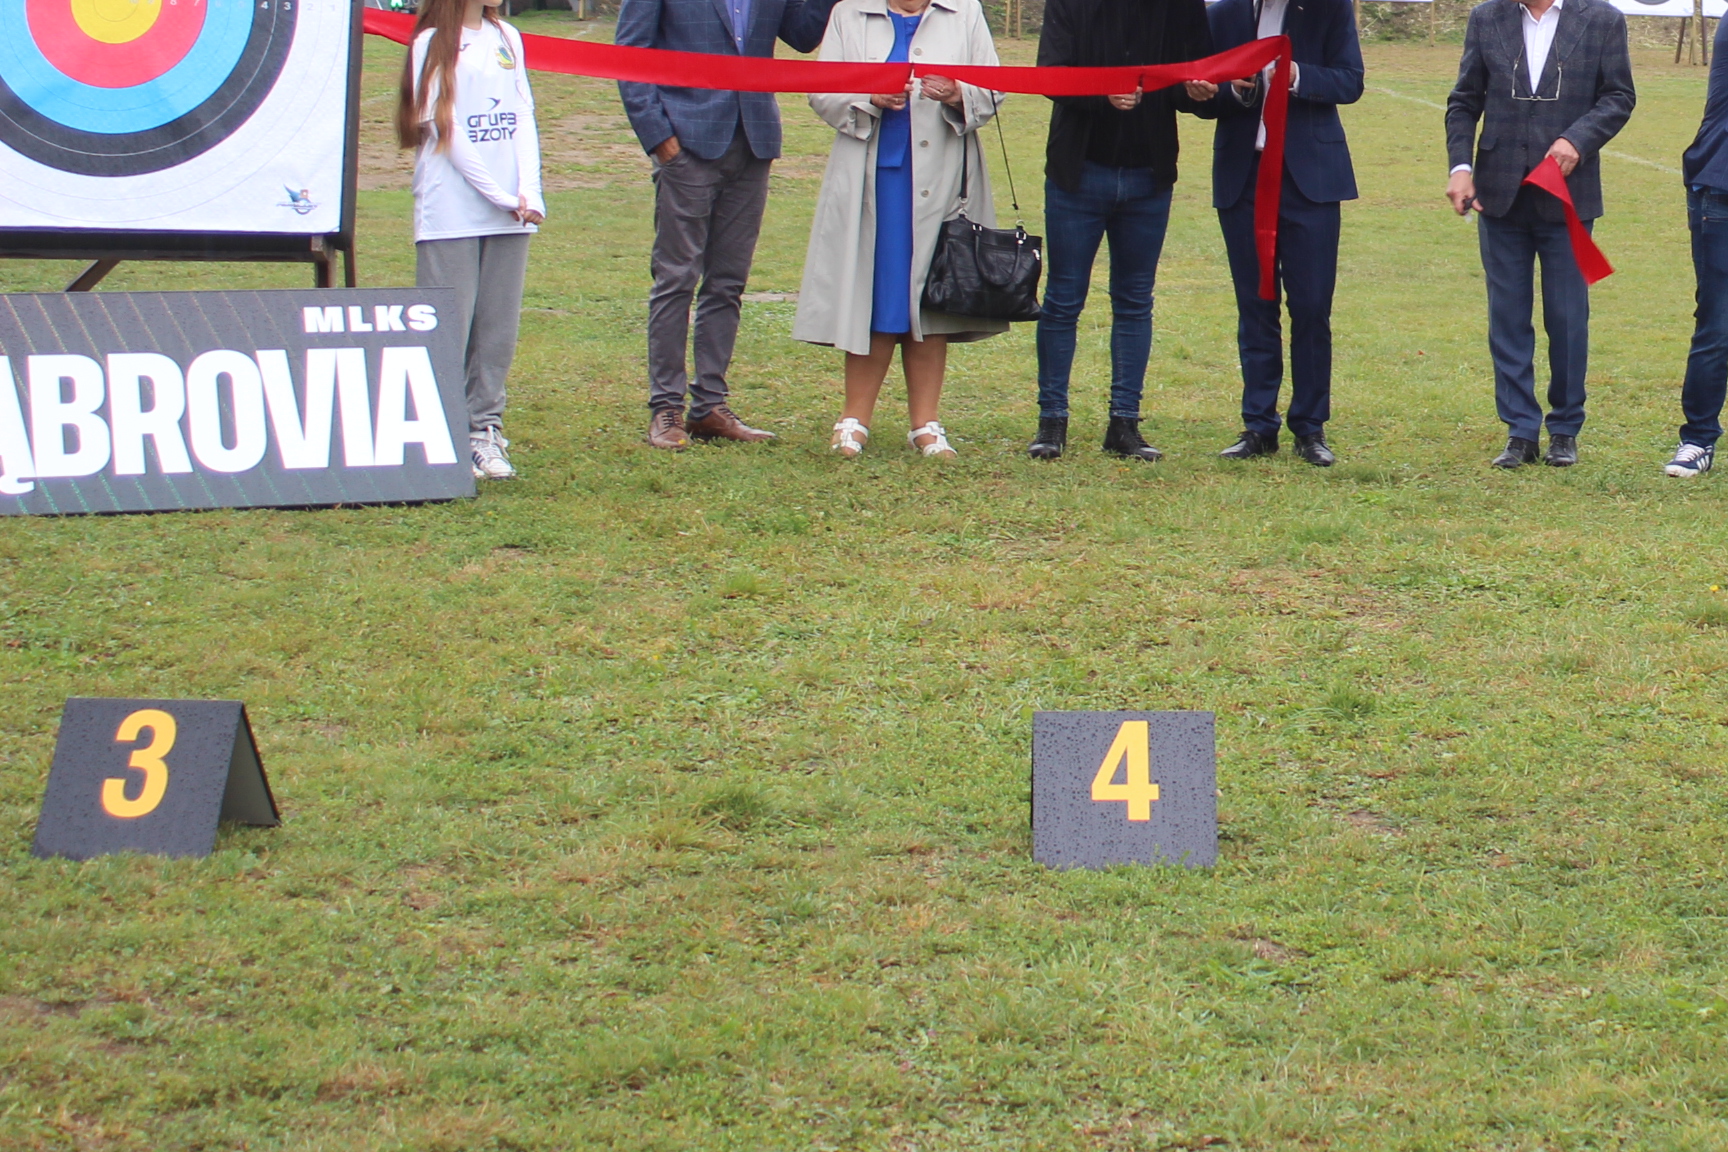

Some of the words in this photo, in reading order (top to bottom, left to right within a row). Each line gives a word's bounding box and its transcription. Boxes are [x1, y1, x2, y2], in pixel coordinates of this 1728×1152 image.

[261, 1, 269, 9] 4
[284, 2, 292, 10] 3
[302, 304, 439, 333] MLKS
[101, 709, 176, 818] 3
[1091, 720, 1160, 821] 4
